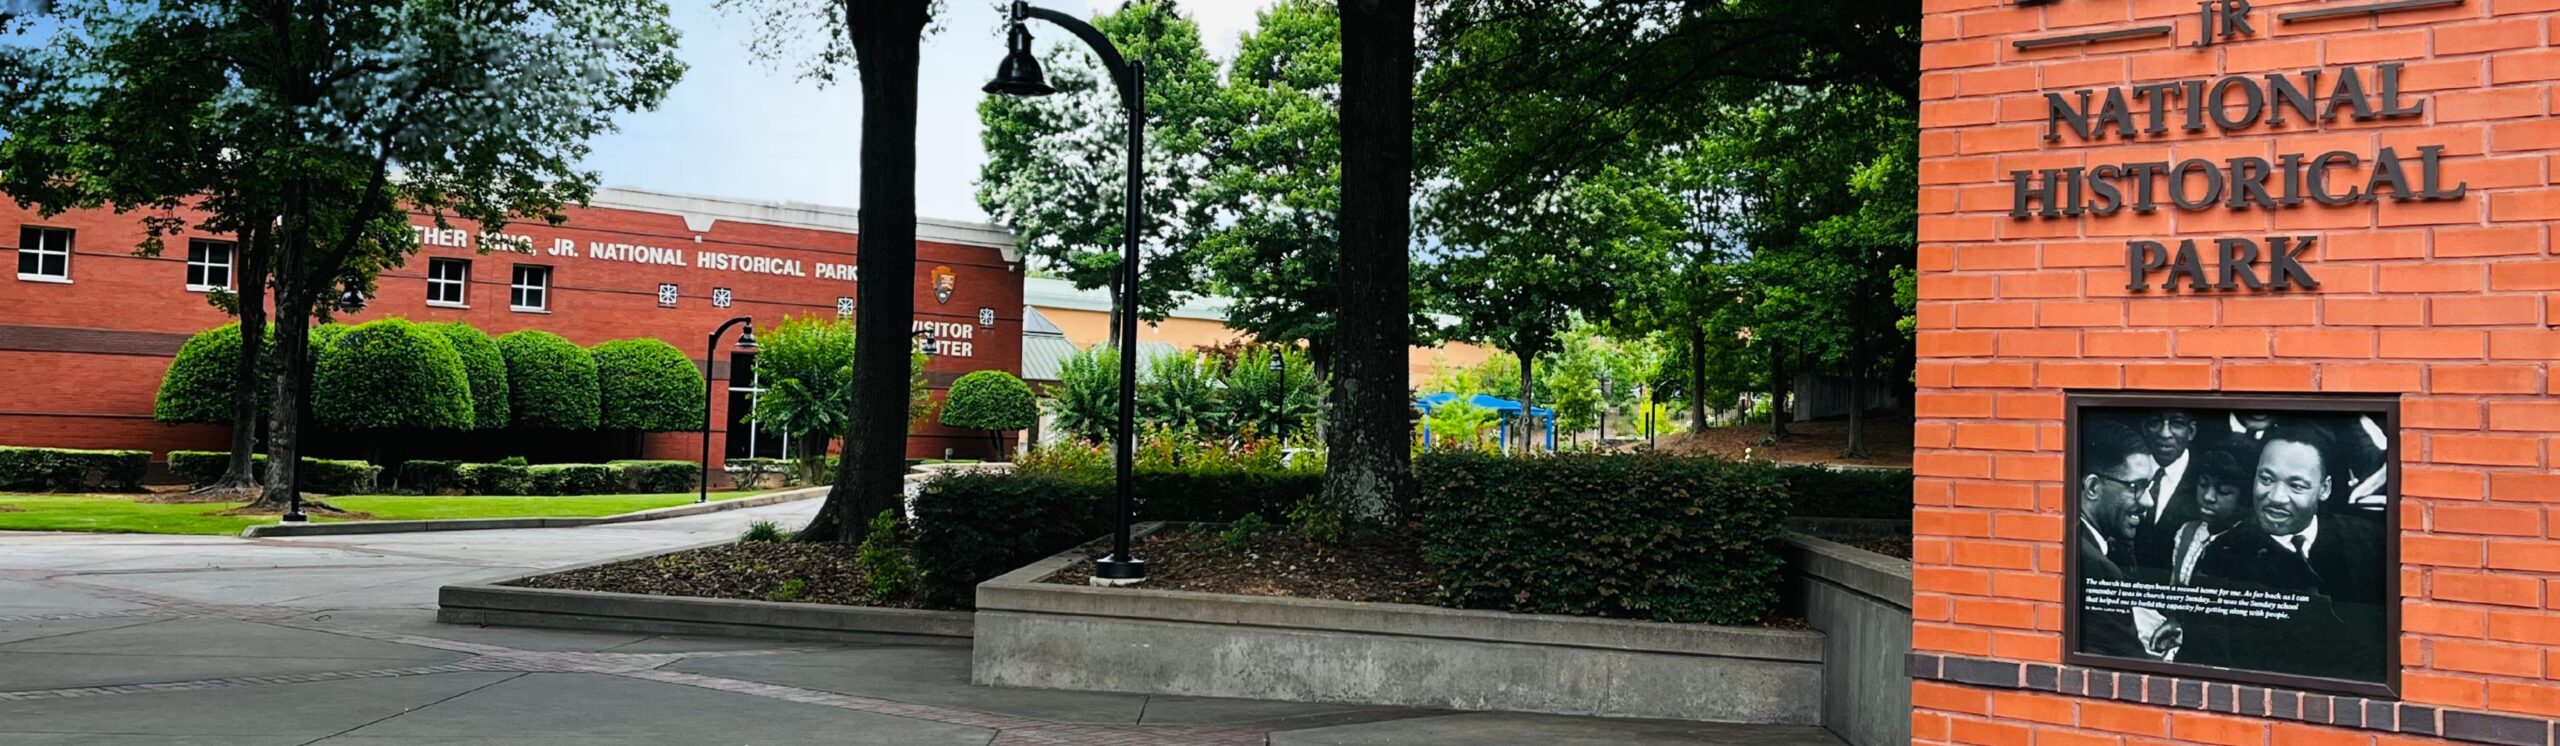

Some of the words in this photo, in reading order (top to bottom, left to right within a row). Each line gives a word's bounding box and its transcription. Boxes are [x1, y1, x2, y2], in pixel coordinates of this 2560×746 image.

[2192, 0, 2255, 49] JR
[2043, 63, 2424, 141] NATIONAL
[2009, 144, 2466, 218] HISTORICAL
[404, 225, 467, 248] THER
[548, 238, 579, 257] JR.
[590, 241, 687, 266] NATIONAL
[697, 251, 806, 277] HISTORICAL
[816, 262, 858, 281] PARK
[2126, 235, 2320, 292] PARK
[2085, 588, 2117, 596] remember
[2143, 592, 2165, 600] church
[2250, 600, 2276, 610] Sunday
[2277, 602, 2299, 610] school
[2098, 579, 2119, 587] church
[2155, 582, 2170, 590] been
[2218, 588, 2229, 597] for
[2253, 591, 2264, 599] far
[2264, 591, 2281, 600] back
[2099, 596, 2119, 605] helped
[2166, 603, 2194, 612] capacity
[2194, 604, 2205, 612] for
[2205, 605, 2228, 615] getting
[2229, 608, 2248, 617] along
[2249, 609, 2264, 617] with
[2265, 611, 2290, 620] people.
